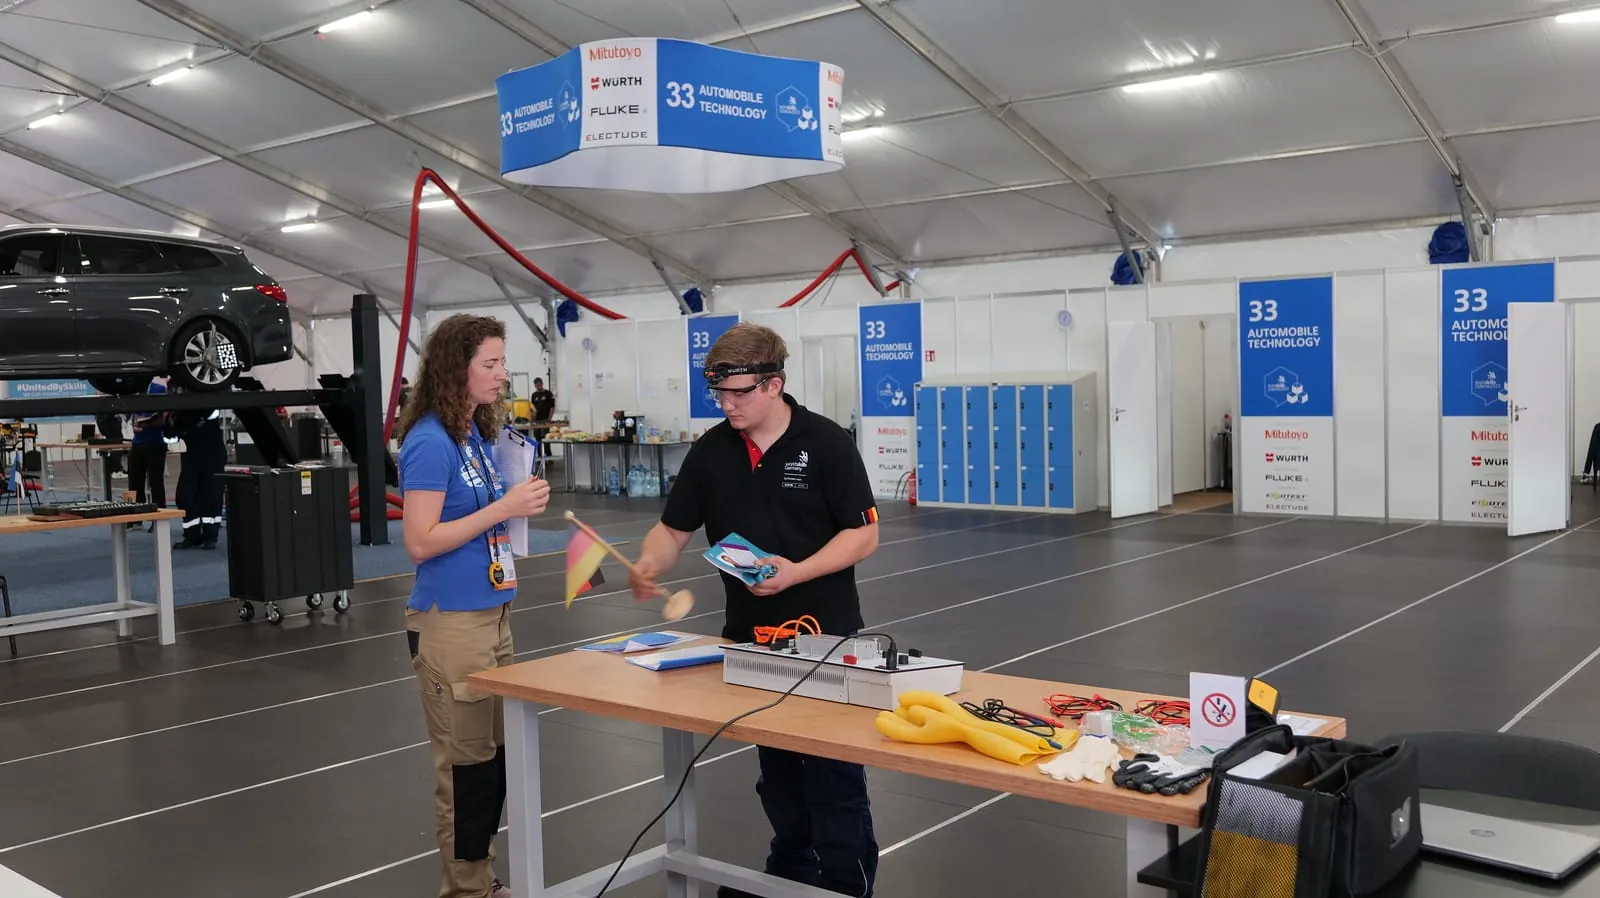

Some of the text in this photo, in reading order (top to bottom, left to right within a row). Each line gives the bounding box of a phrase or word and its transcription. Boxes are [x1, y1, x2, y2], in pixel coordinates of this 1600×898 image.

[589, 45, 641, 61] Mitutoyo
[666, 81, 695, 109] 33
[699, 84, 764, 104] AUTOMOBILE
[514, 97, 553, 118] AUTOMOBILE
[590, 104, 639, 117] FLUKE
[699, 100, 767, 120] TECHNOLOGY
[500, 111, 514, 137] 33
[515, 114, 556, 134] TECHNOLOGY
[585, 131, 648, 142] ELECTUDE
[1453, 287, 1488, 313] 33
[1248, 299, 1278, 322] 33
[865, 320, 886, 340] 33
[1247, 326, 1319, 338] AUTOMOBILE
[692, 331, 710, 349] 33
[864, 342, 913, 352] AUTOMOBILE
[1247, 337, 1321, 349] TECHNOLOGY
[865, 351, 914, 361] TECHNOLOGY
[1264, 429, 1309, 442] Mitutoyo
[1265, 474, 1303, 482] FLUKE
[1471, 479, 1508, 487] FLUK
